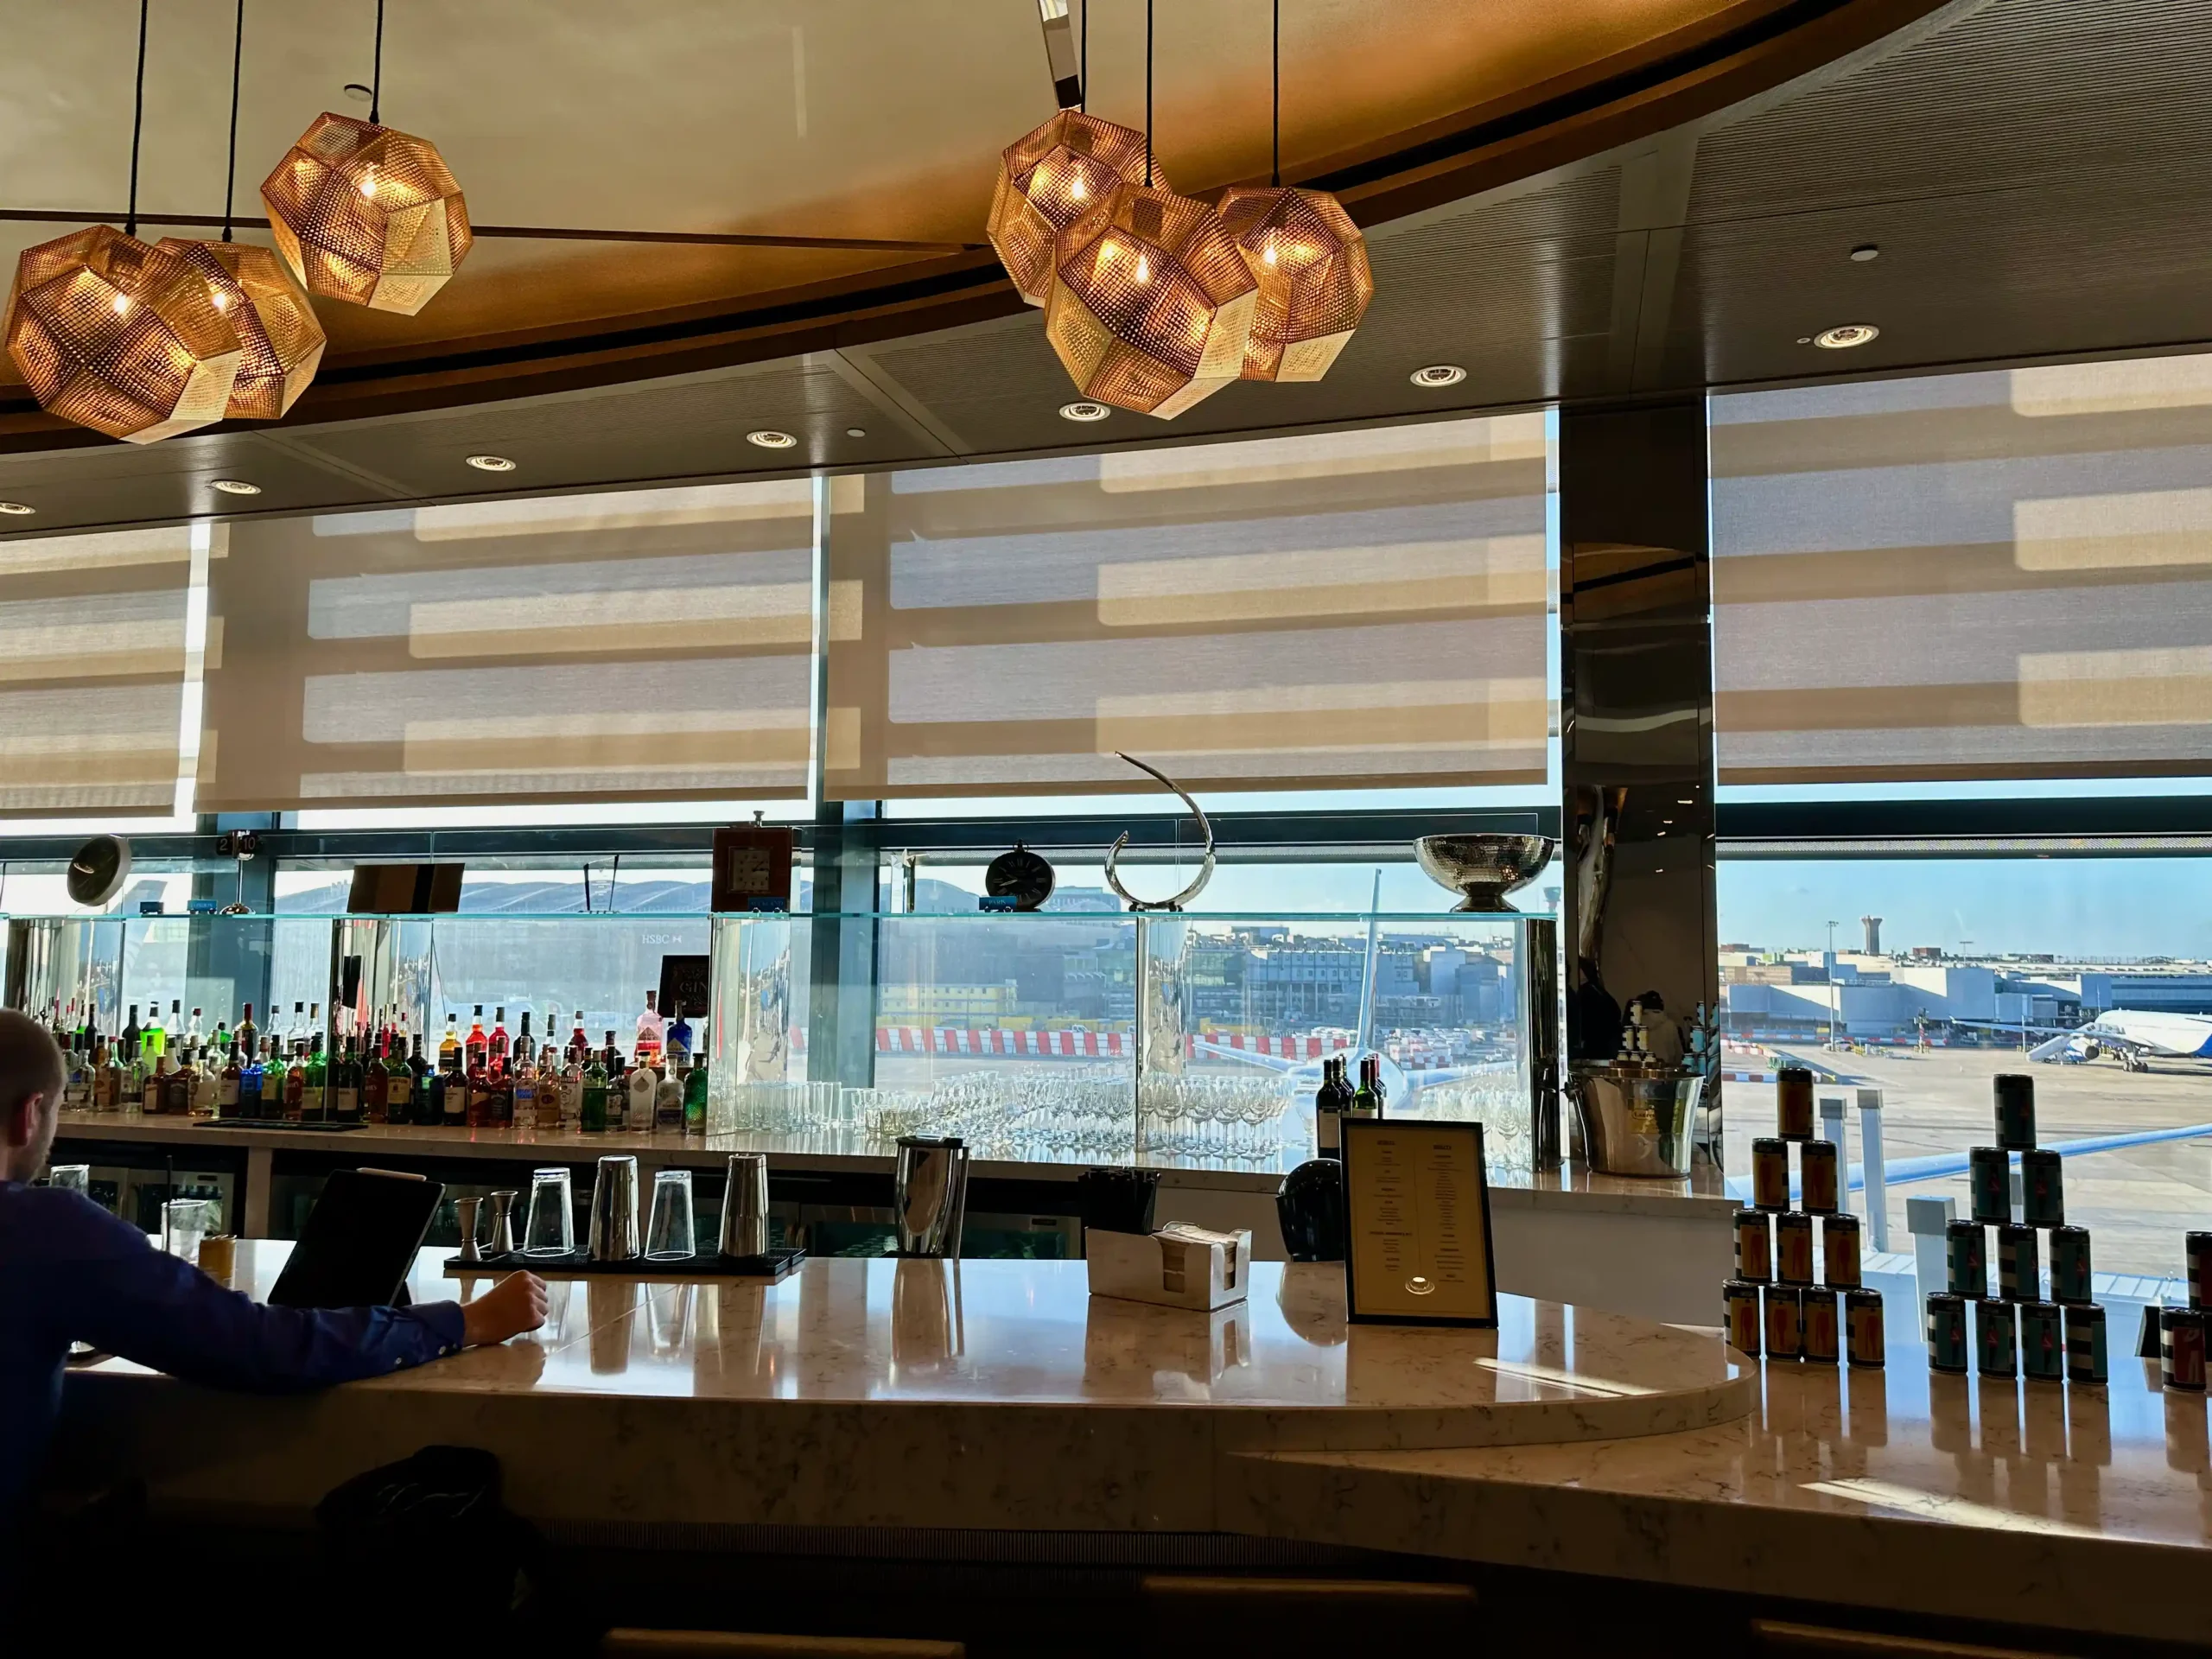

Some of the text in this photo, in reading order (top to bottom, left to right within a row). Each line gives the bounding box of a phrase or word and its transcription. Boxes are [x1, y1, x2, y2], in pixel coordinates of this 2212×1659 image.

[219, 836, 256, 851] 2 10
[641, 934, 670, 944] HSBC
[679, 981, 708, 993] GIN
